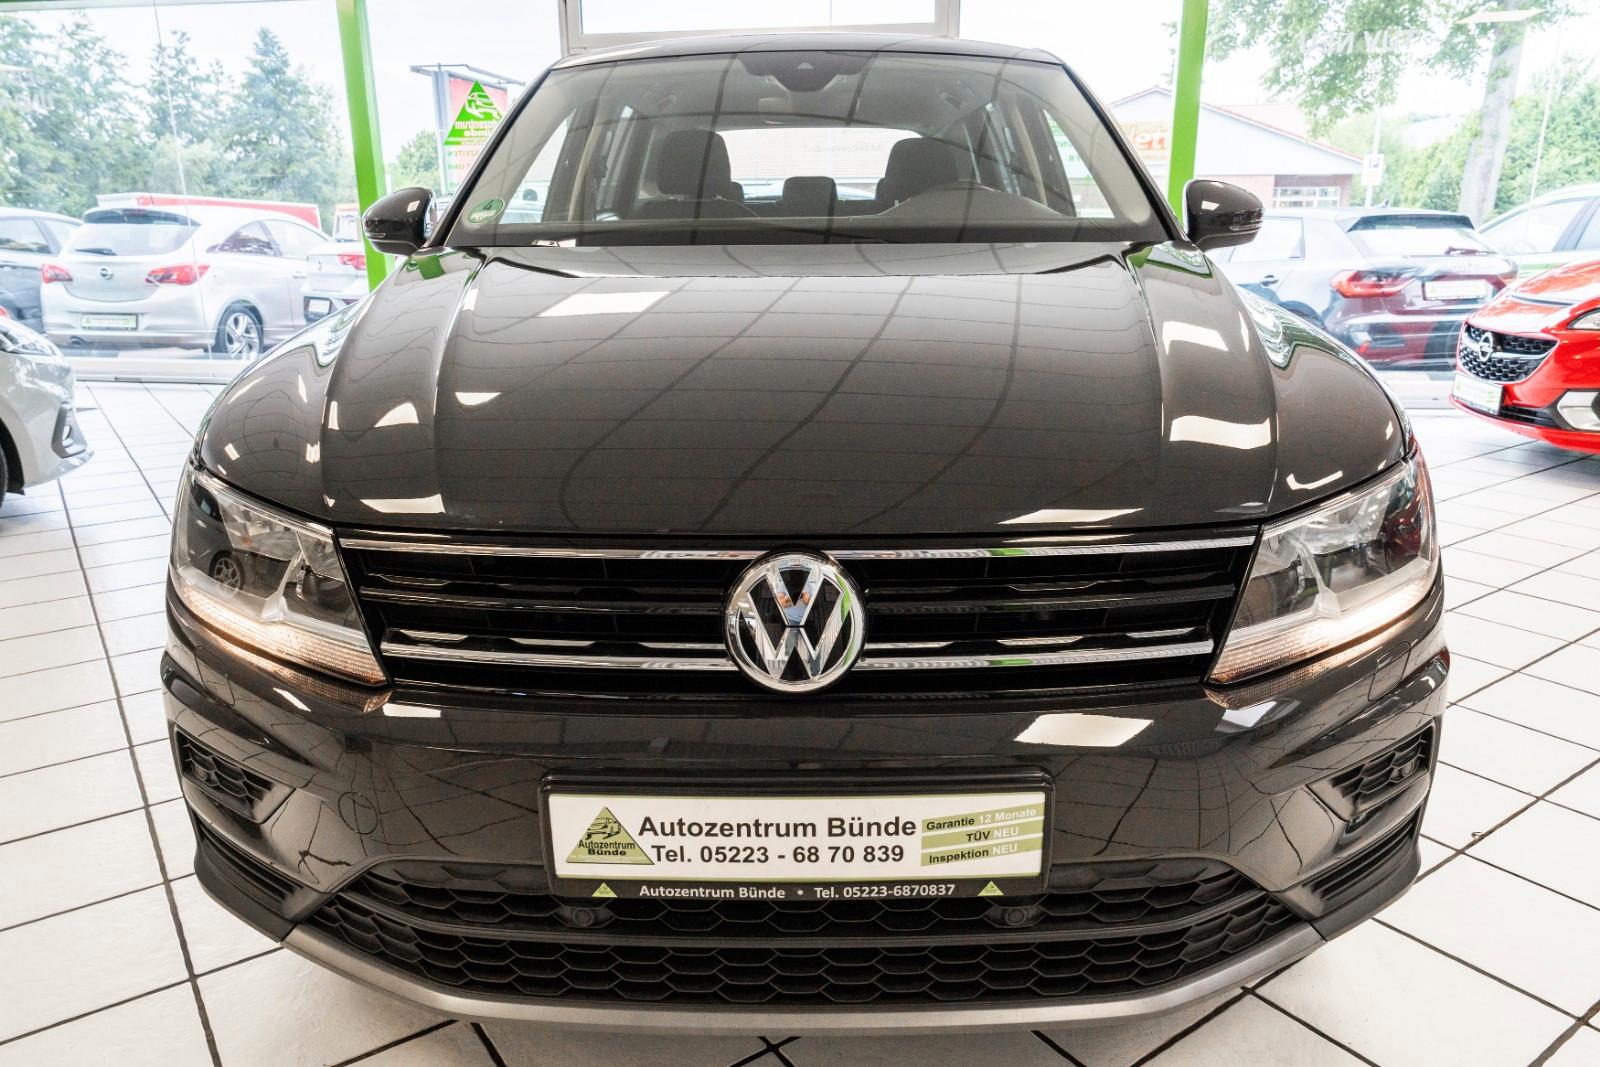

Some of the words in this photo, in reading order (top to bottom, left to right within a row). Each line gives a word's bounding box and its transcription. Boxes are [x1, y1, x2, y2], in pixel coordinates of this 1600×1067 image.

[482, 199, 495, 210] 4
[638, 816, 817, 838] Autozentrum
[827, 816, 917, 837] Bünde
[926, 816, 976, 831] Garantie
[979, 814, 992, 824] 12
[995, 808, 1037, 821] Monate
[966, 830, 992, 842] TÜV
[993, 826, 1019, 839] NEU
[578, 839, 636, 850] Autozentrum
[587, 848, 627, 856] Bünde
[651, 845, 692, 863] Tel.
[700, 845, 769, 864] 05223
[793, 846, 819, 863] 68
[828, 845, 855, 863] 70
[863, 844, 904, 863] 839
[929, 849, 989, 864] Inspektion
[992, 843, 1018, 856] NEU
[639, 885, 735, 898] Autozentrum
[738, 887, 786, 899] Bünde
[813, 887, 839, 898] Tel.
[843, 884, 956, 898] 05223-6870837
